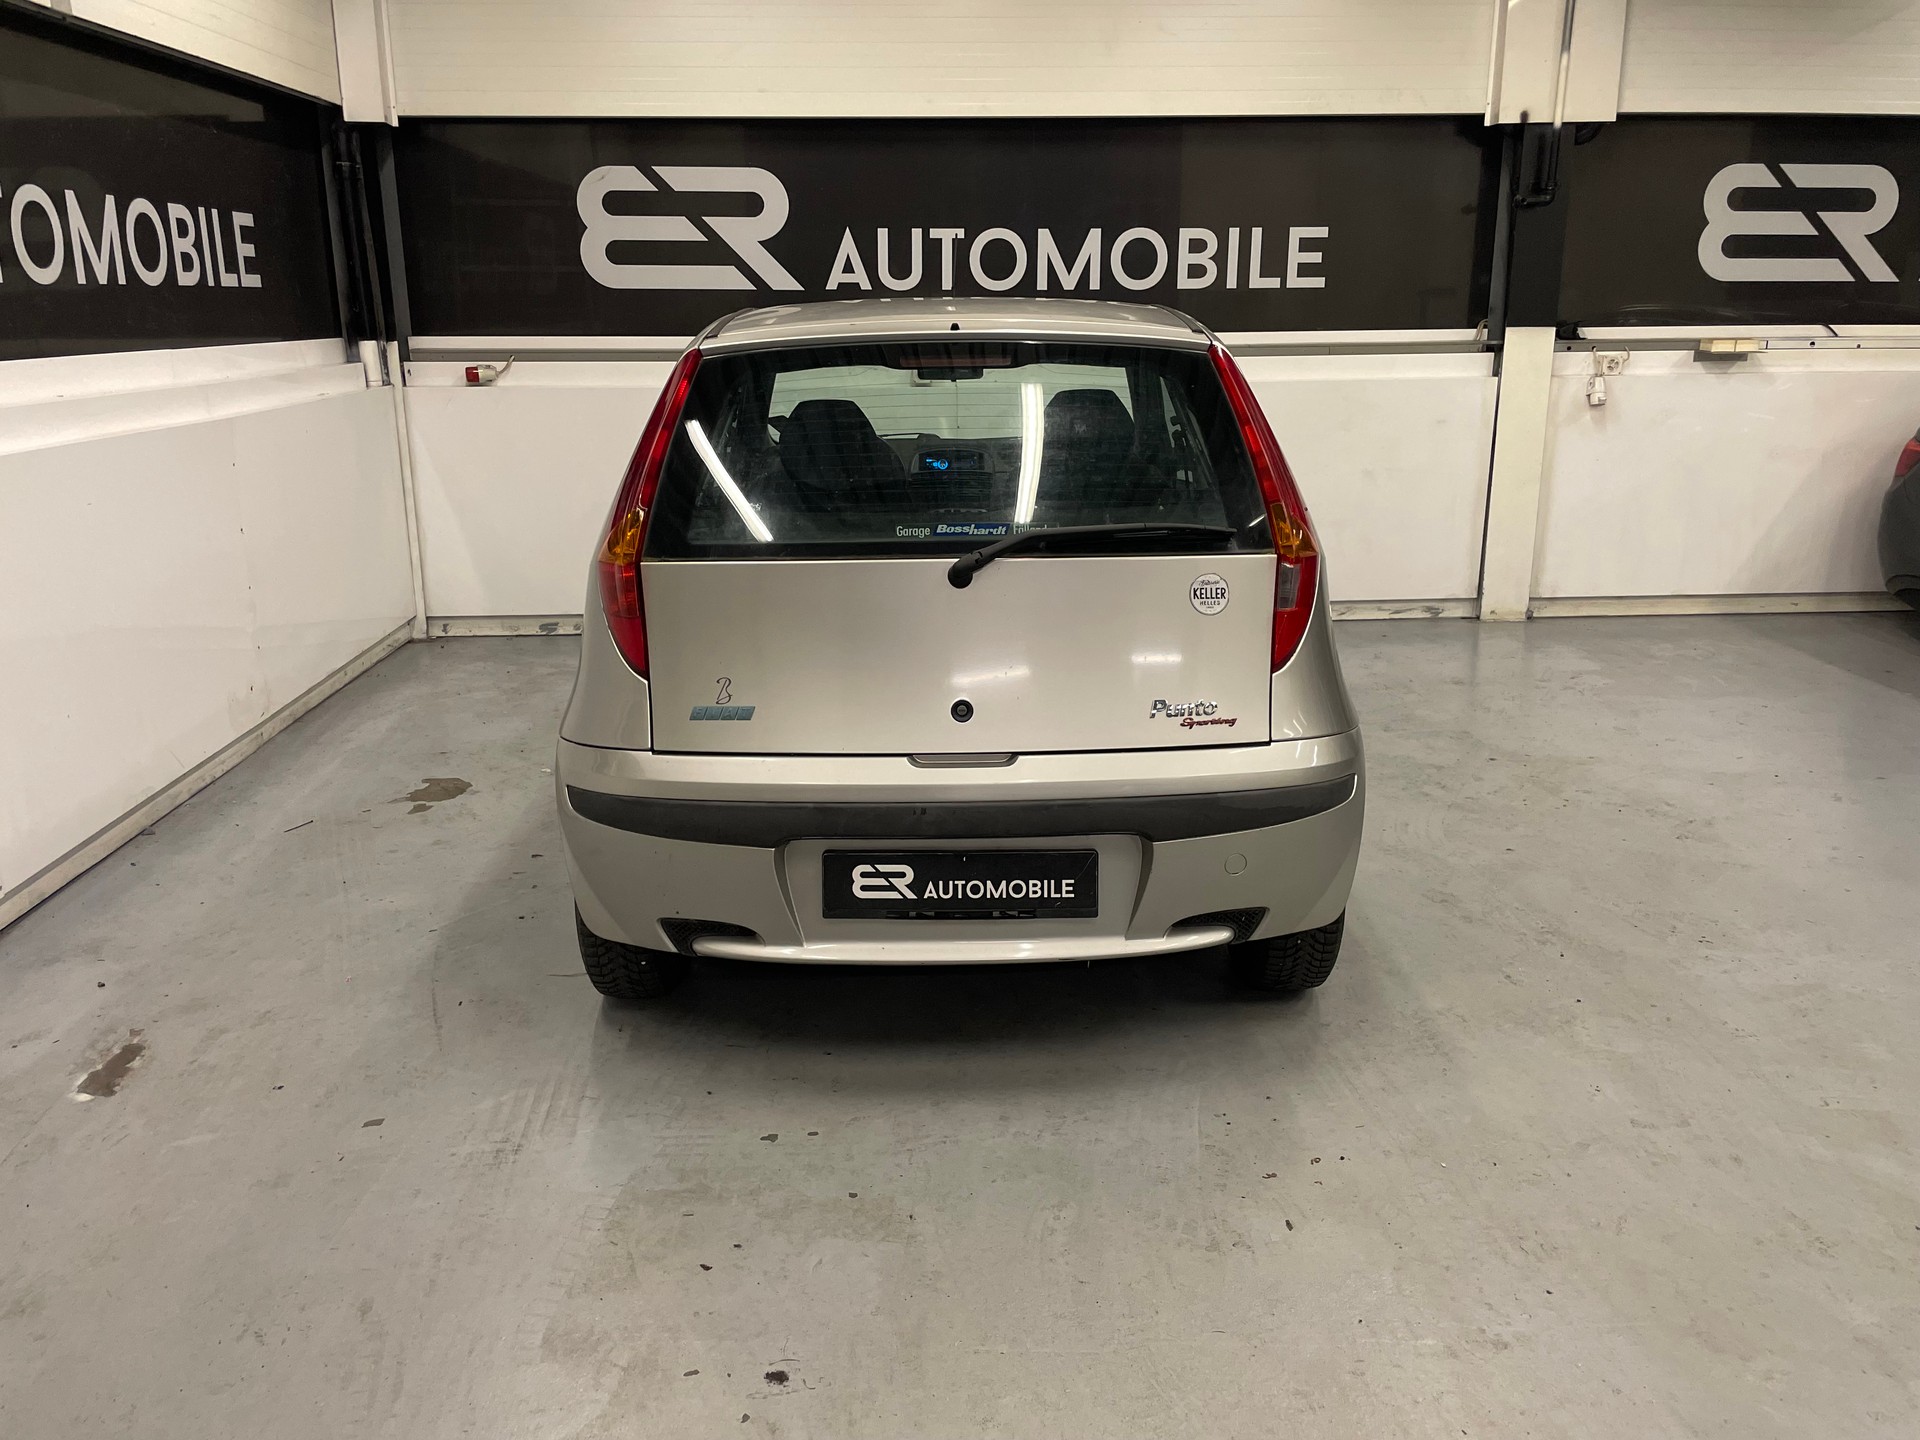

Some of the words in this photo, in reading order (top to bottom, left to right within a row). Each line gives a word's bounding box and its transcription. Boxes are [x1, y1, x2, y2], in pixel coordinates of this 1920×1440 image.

[0, 183, 262, 288] OMOBILE
[825, 226, 1329, 291] AUTOMOBILE
[896, 525, 931, 539] Garage
[936, 523, 1007, 536] Bosshardt
[1193, 587, 1227, 600] KELLER
[1149, 699, 1218, 719] Punto
[923, 879, 1075, 899] AUTOMOBILE
